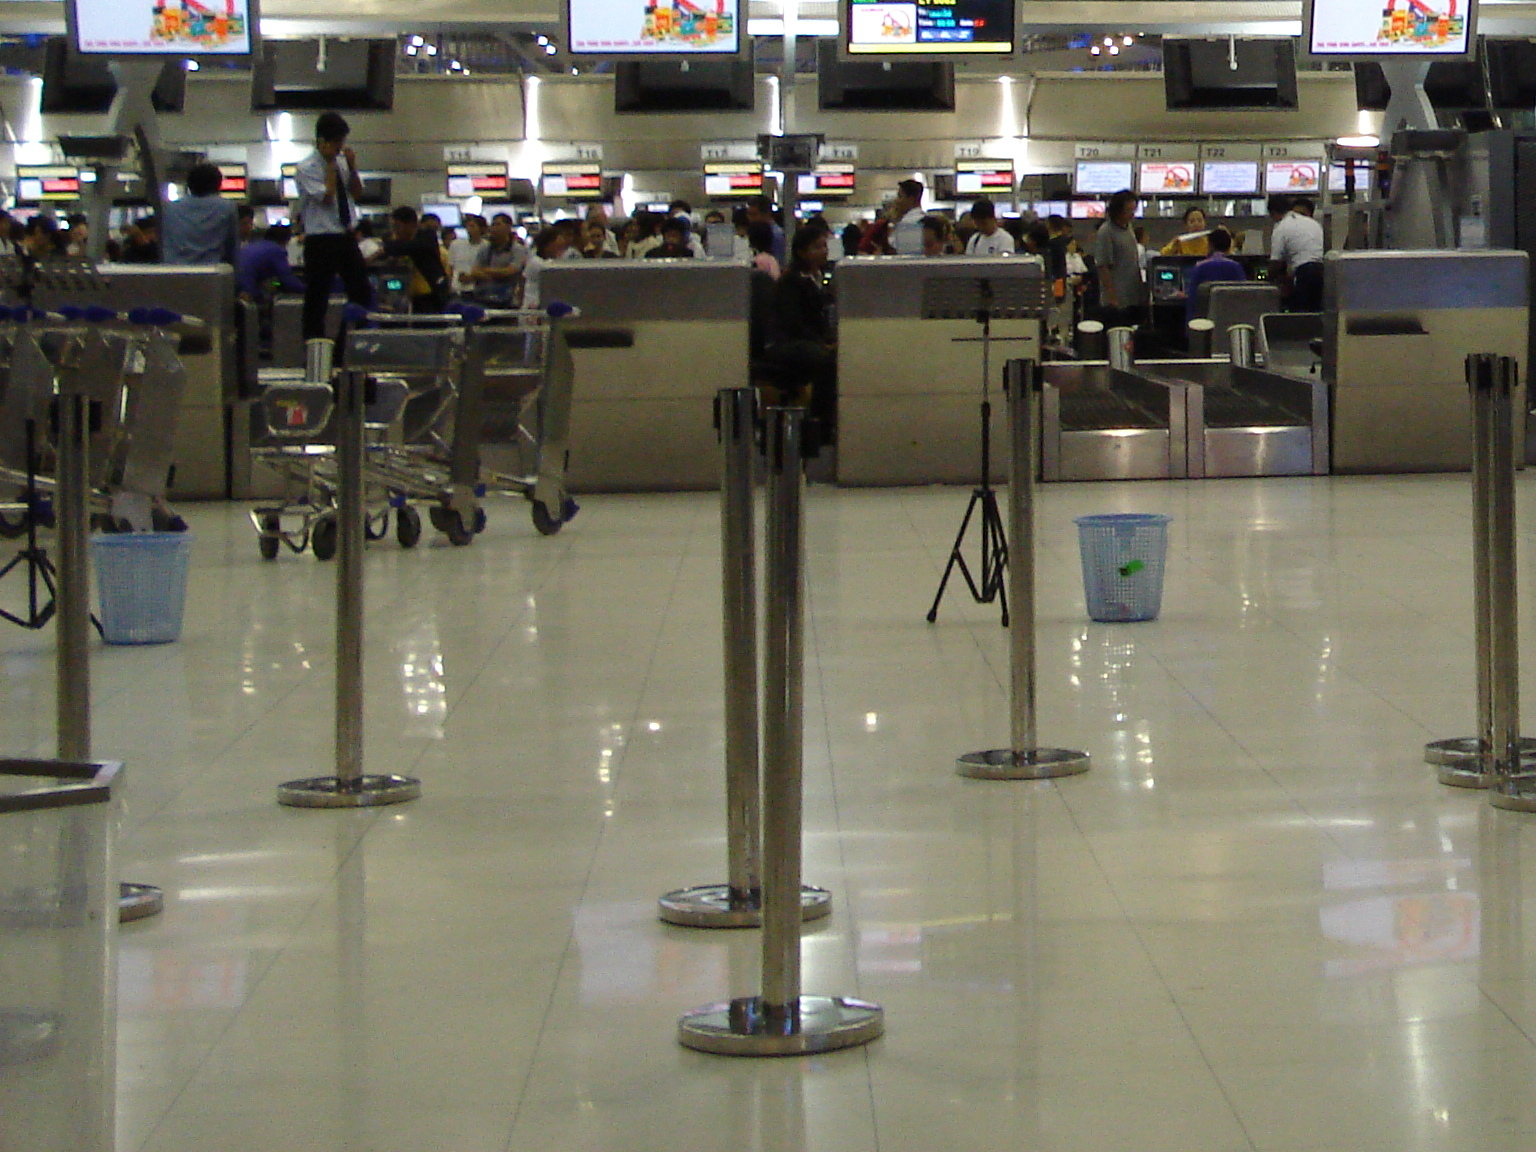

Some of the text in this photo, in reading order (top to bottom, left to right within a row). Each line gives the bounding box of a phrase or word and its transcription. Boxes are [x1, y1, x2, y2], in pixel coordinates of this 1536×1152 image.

[959, 147, 979, 157] T19
[1080, 148, 1099, 156] T20
[1143, 148, 1161, 156] T21
[1206, 148, 1225, 157] T22
[1269, 147, 1287, 156] T23
